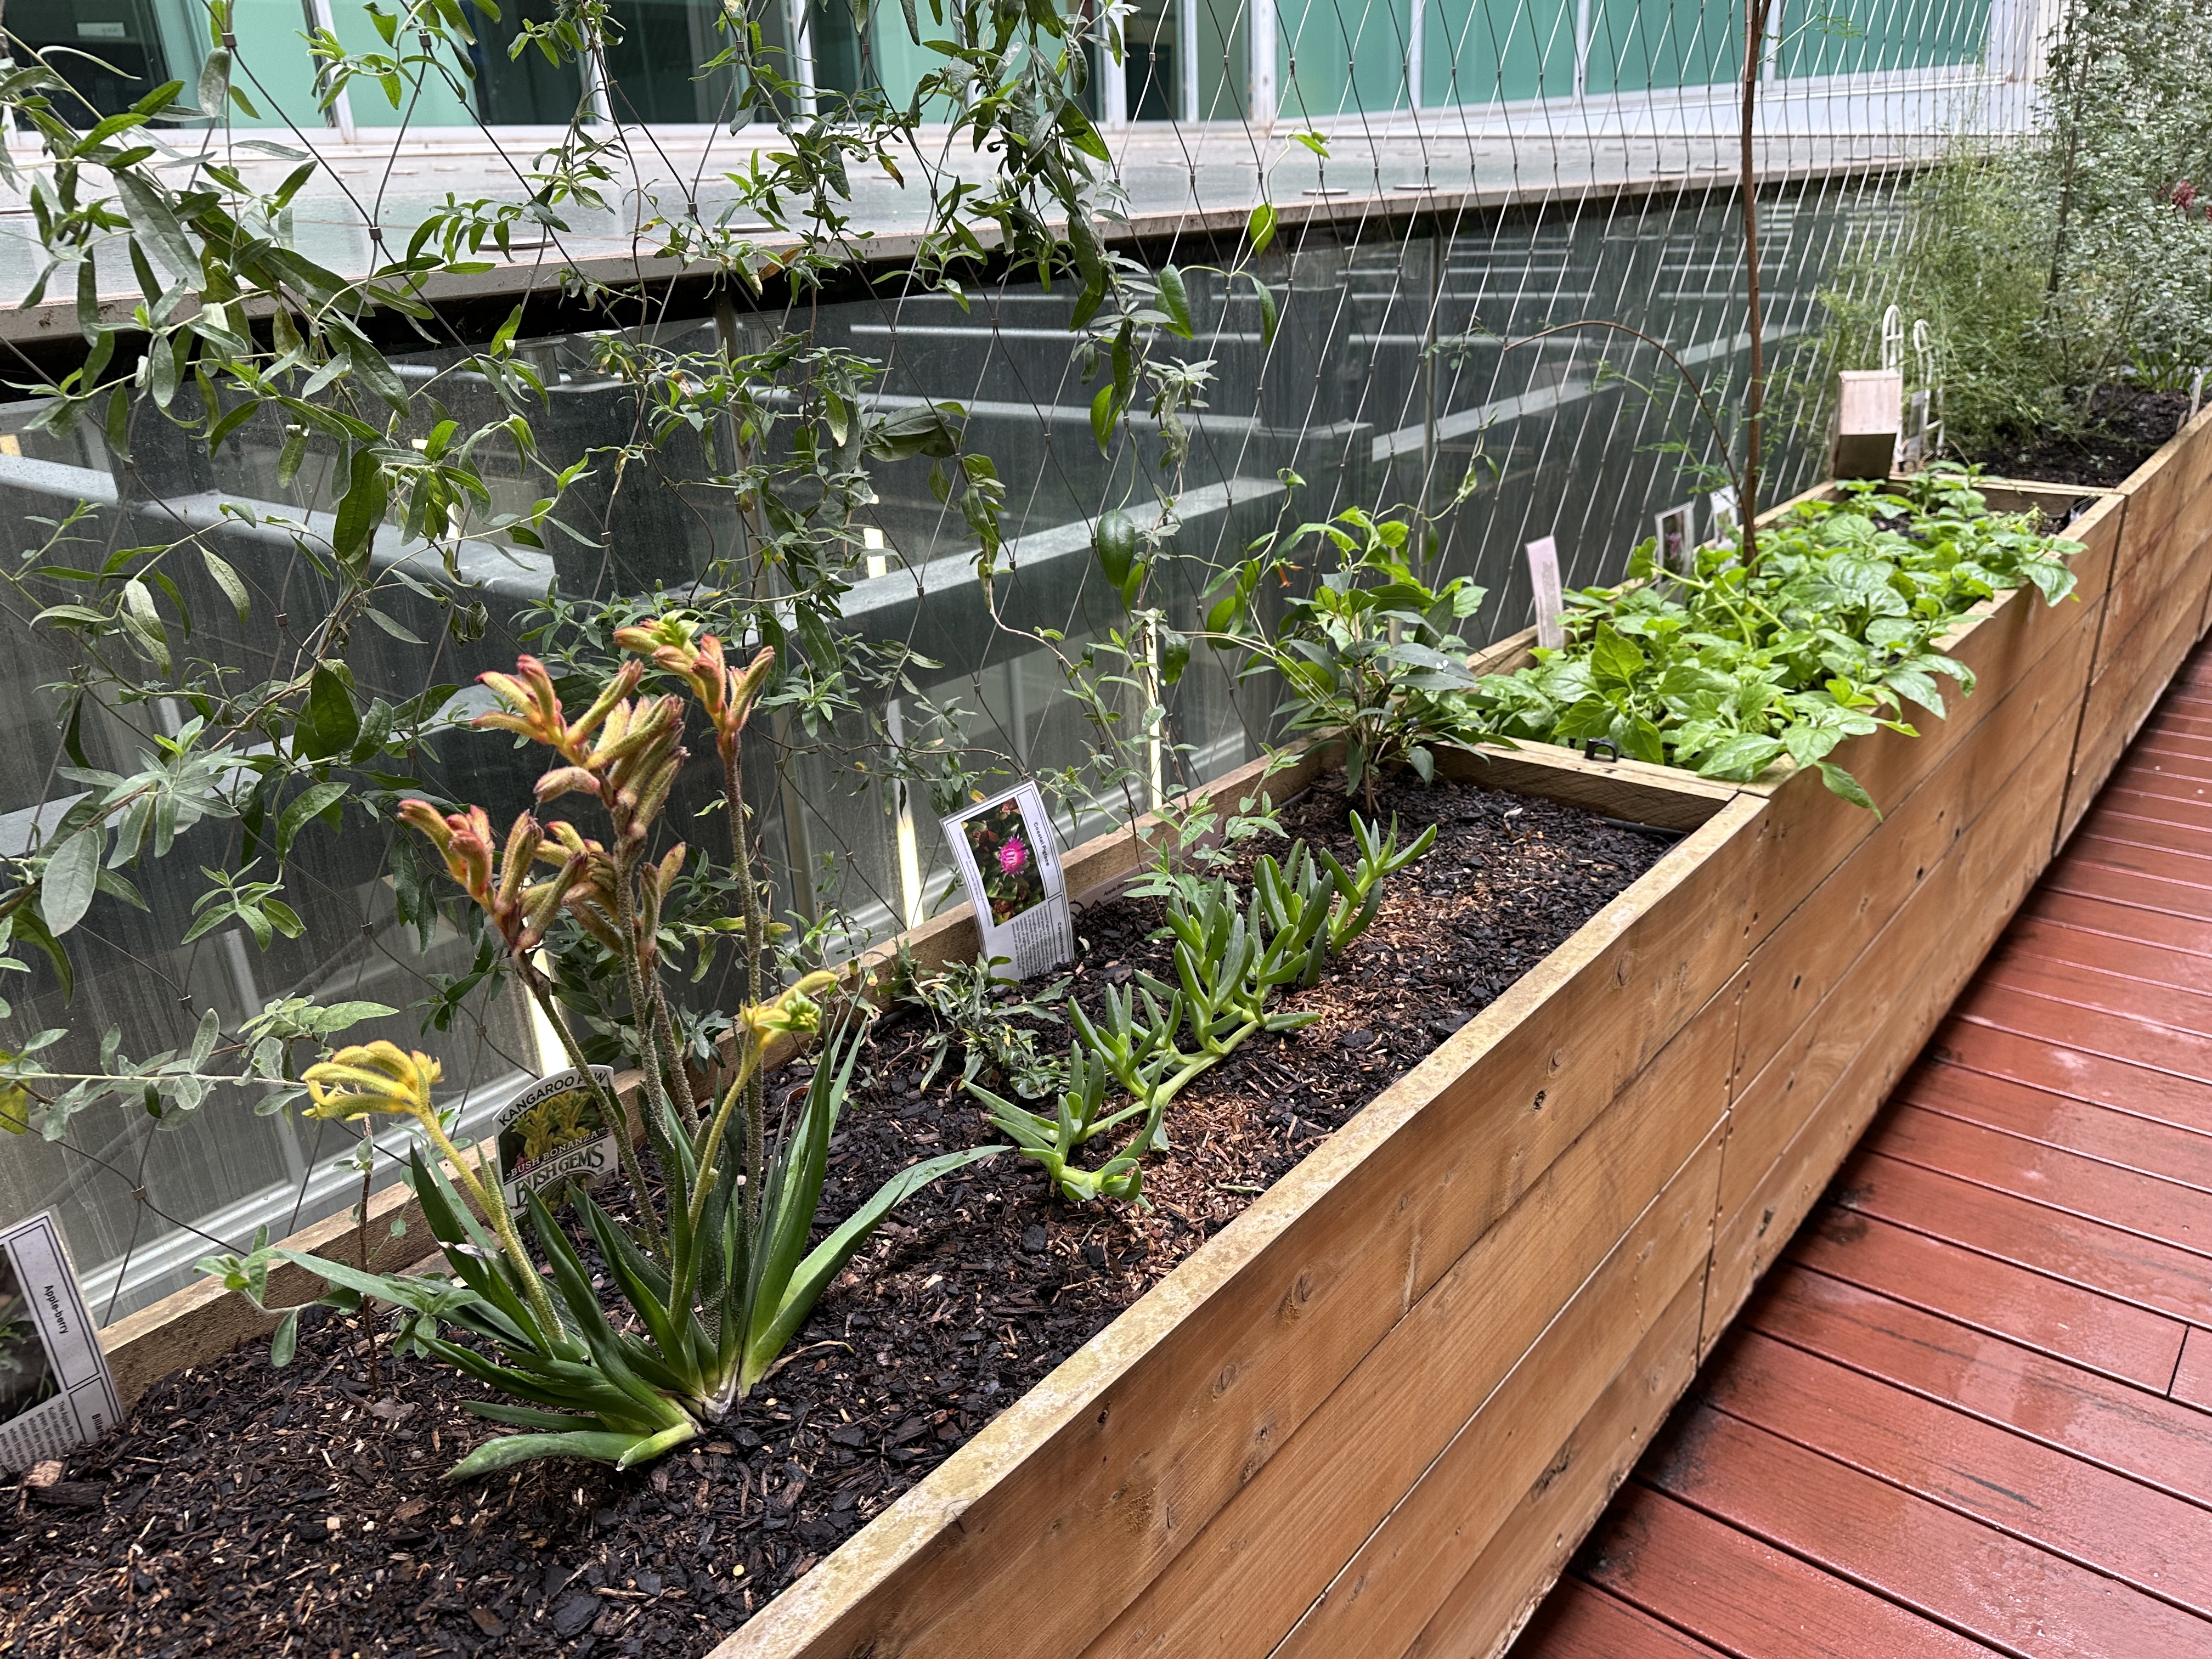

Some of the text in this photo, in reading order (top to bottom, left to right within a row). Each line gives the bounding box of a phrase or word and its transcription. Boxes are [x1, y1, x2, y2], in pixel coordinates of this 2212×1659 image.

[1034, 822, 1045, 844] Coastal
[499, 1071, 607, 1126] KANGAROO PW
[514, 1161, 557, 1207] BUSH
[44, 1285, 69, 1334] Apple-berry
